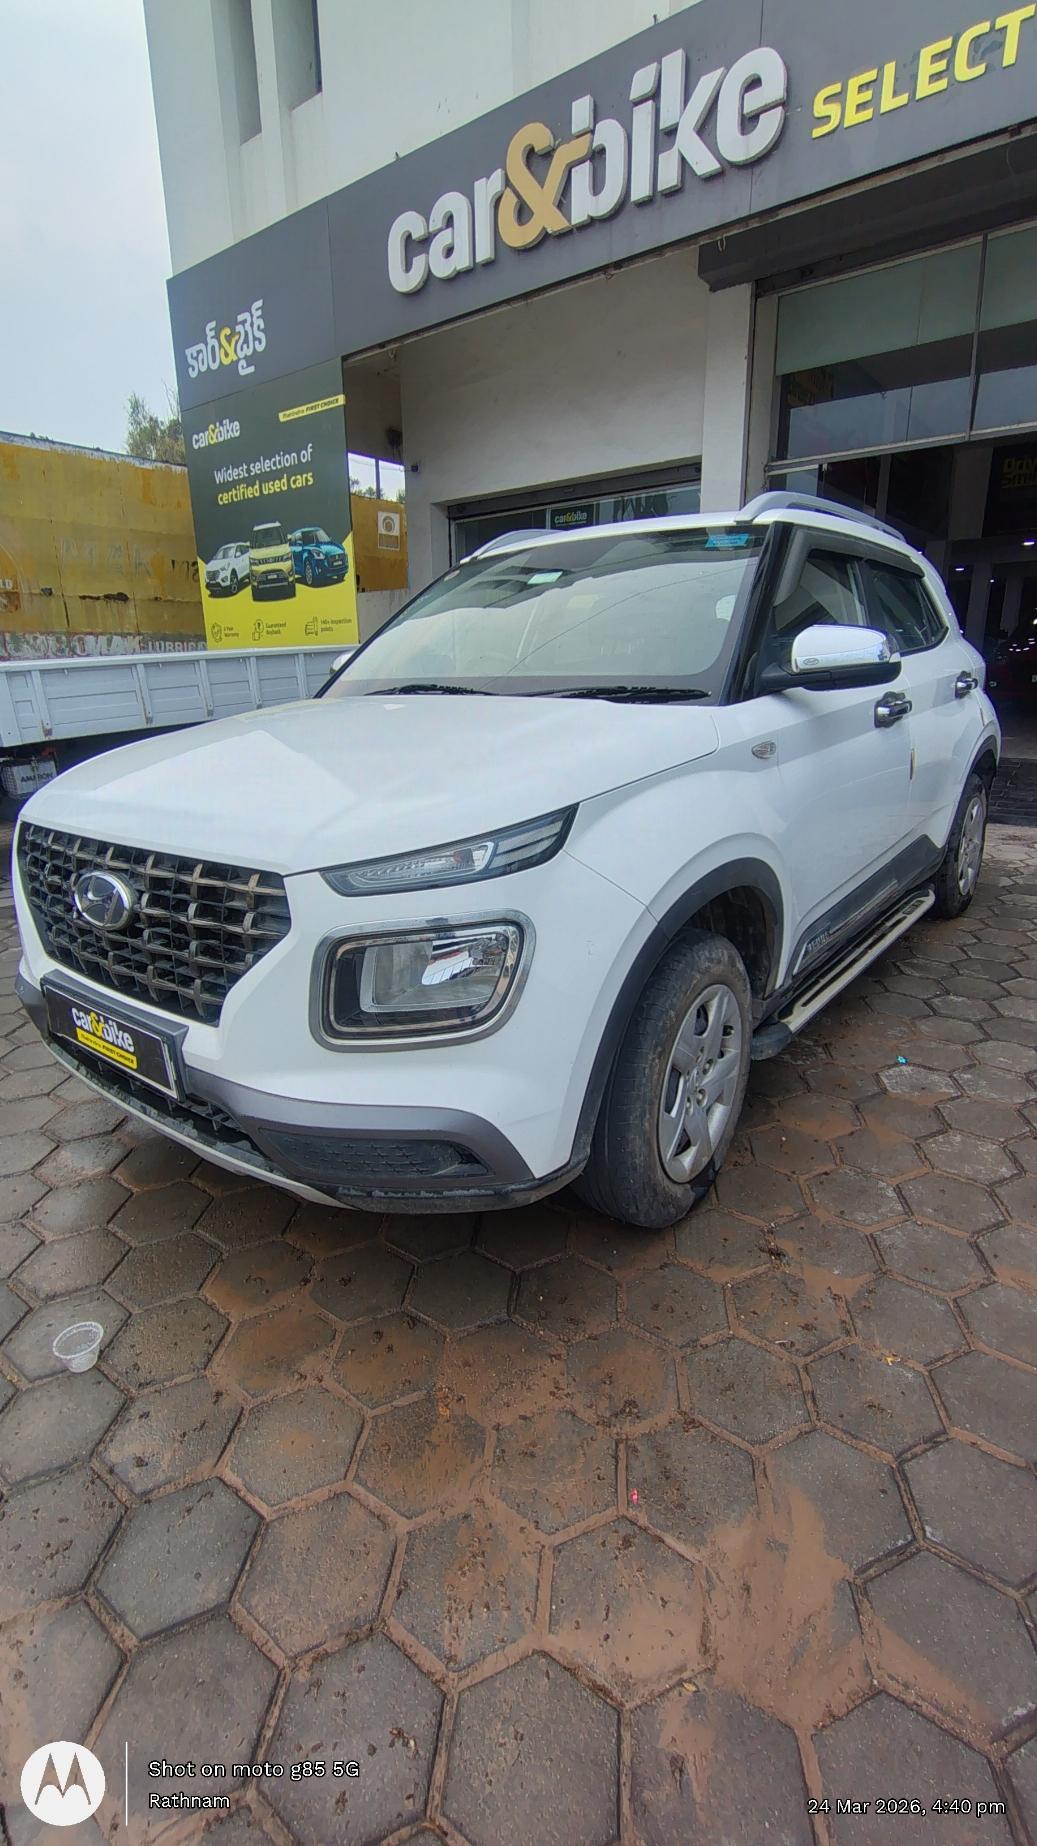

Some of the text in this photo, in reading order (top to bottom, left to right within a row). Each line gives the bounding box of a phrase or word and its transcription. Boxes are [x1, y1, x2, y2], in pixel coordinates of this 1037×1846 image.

[811, 3, 1037, 138] SELECT
[387, 47, 788, 294] car&bike
[192, 418, 241, 449] car&bike
[214, 443, 313, 484] Widest selection of
[217, 472, 314, 505] certified used cars
[71, 1007, 135, 1053] car&bike
